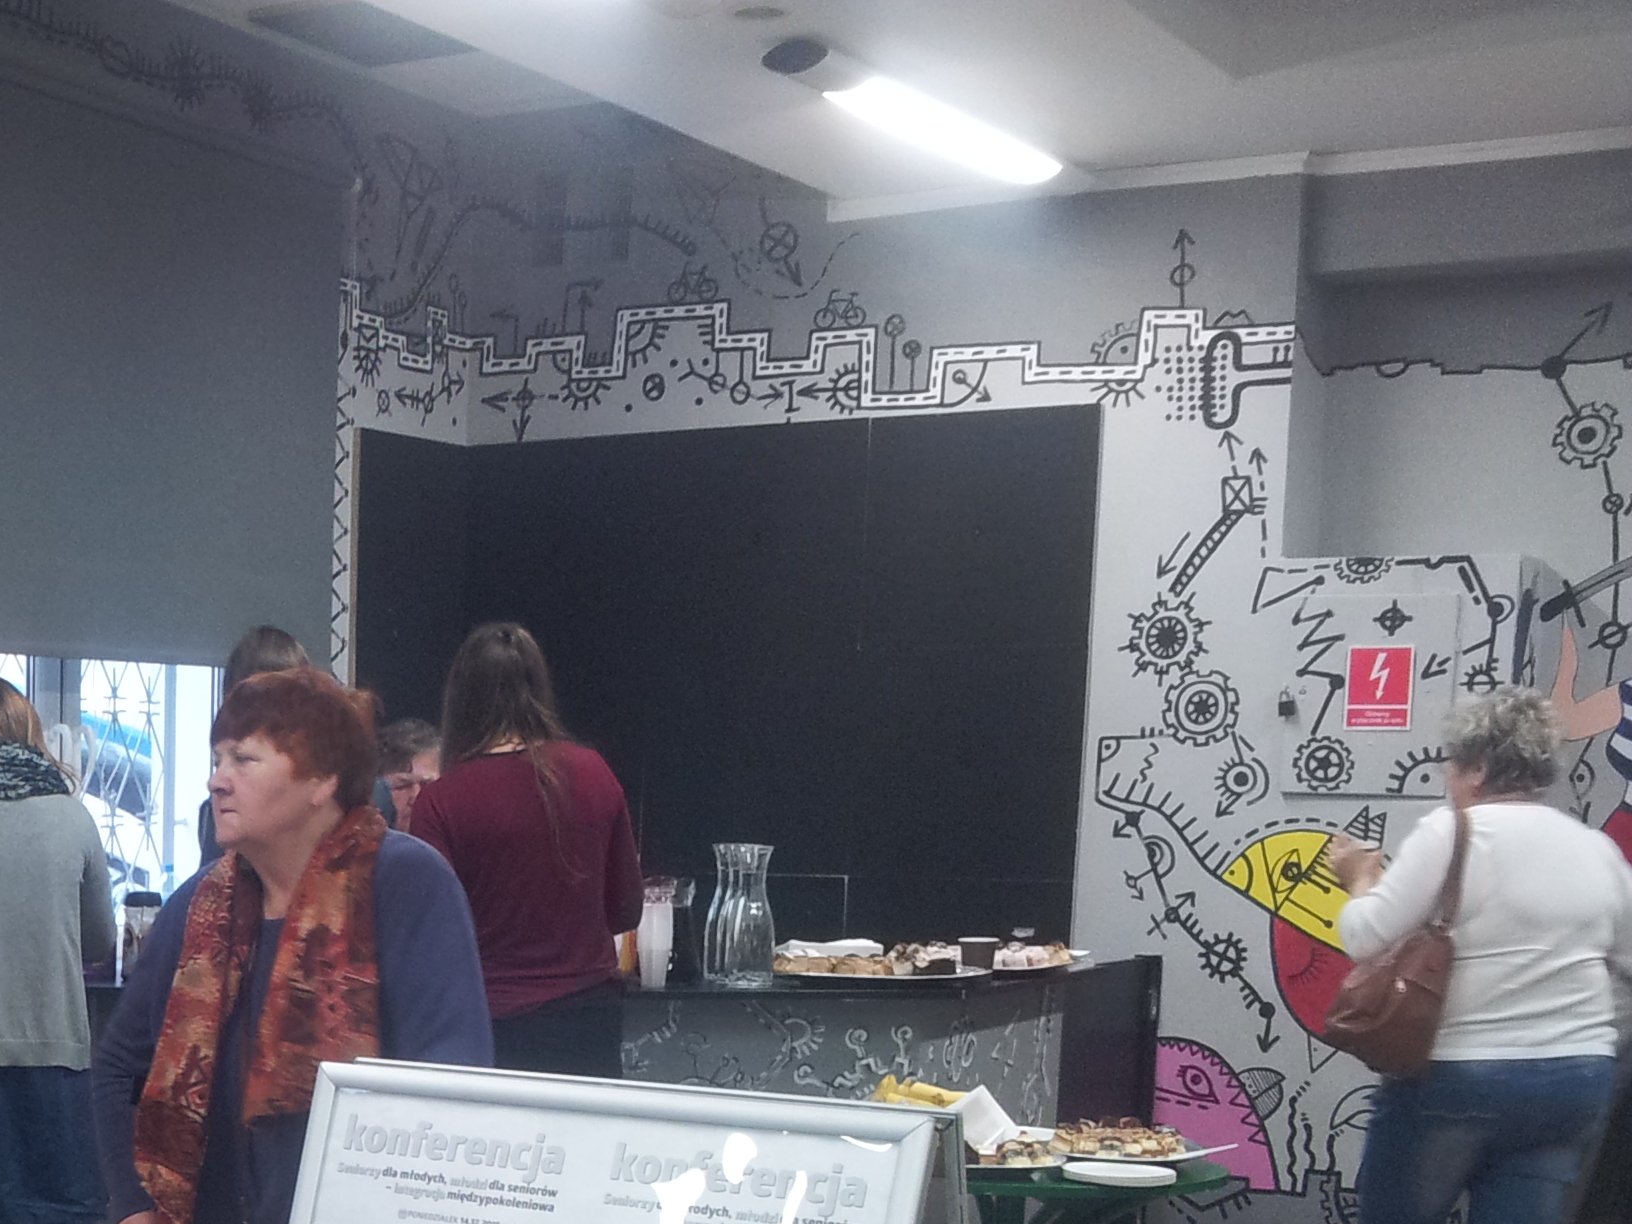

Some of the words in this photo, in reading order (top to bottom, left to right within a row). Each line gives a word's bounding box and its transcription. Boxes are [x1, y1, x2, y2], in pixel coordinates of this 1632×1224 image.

[343, 1113, 566, 1184] konferencja
[382, 1166, 398, 1178] dla
[400, 1169, 447, 1186] młodych,
[489, 1179, 505, 1192] dla
[507, 1183, 558, 1198] seniorów
[447, 1190, 555, 1213] międzypokoleniowa
[602, 1193, 655, 1213] Seniorzy
[735, 1209, 779, 1224] młodzi
